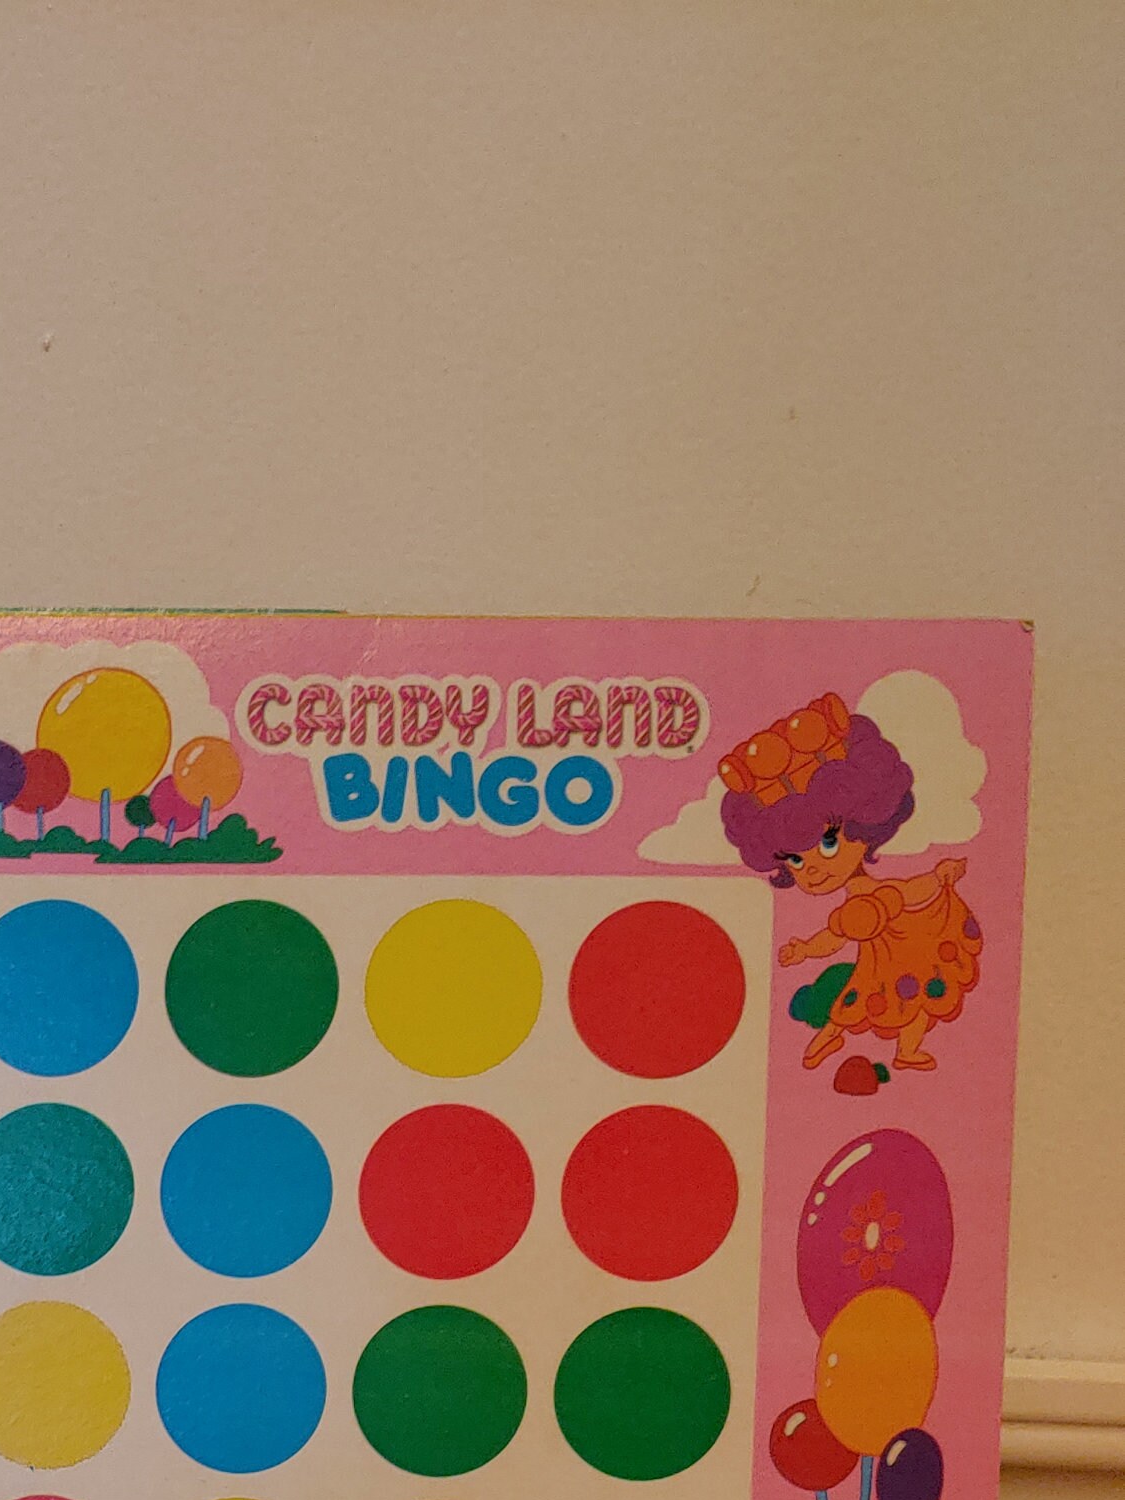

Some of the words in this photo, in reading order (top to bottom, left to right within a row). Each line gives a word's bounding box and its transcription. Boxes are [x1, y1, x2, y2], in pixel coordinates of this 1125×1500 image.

[247, 683, 489, 747] CANDY
[517, 684, 702, 748] LAND
[323, 751, 614, 827] BINGO
